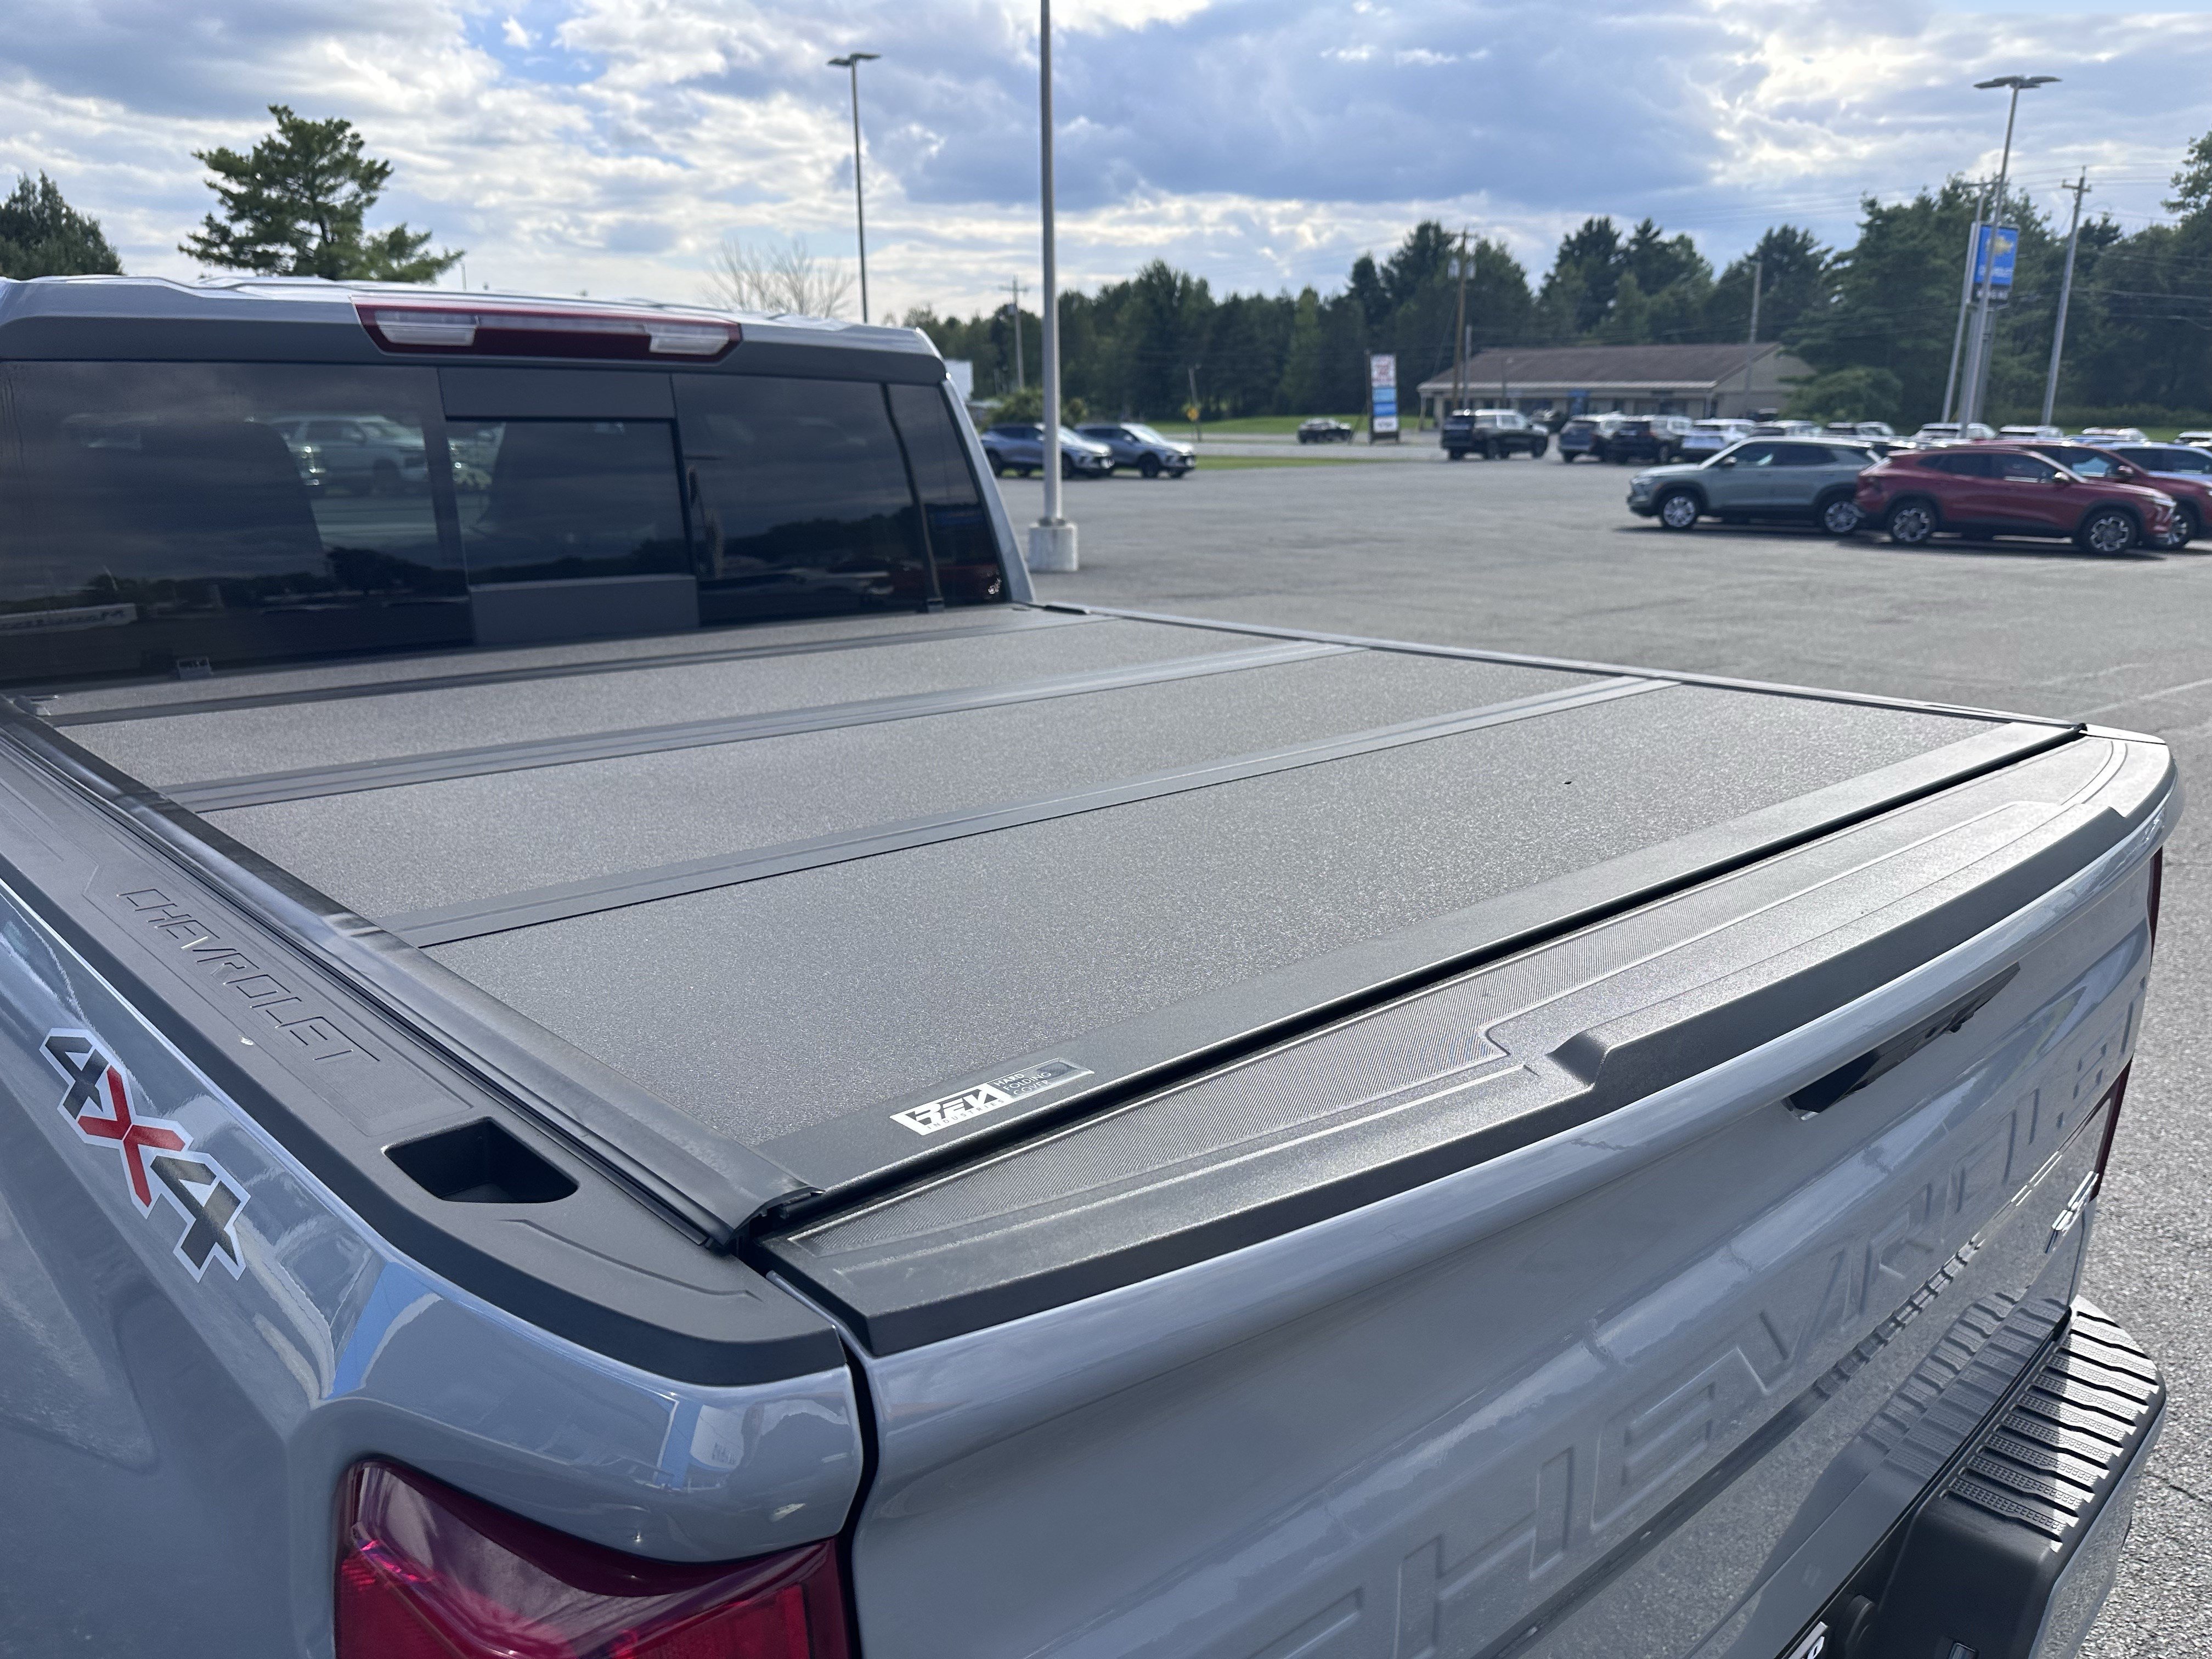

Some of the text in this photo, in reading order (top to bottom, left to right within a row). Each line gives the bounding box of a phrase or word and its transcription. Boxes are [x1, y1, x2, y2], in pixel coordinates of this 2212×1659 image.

[117, 888, 380, 1062] CHEVROLET
[994, 1073, 1025, 1087] HARD
[1003, 1071, 1052, 1091] FOLDING
[905, 1088, 998, 1125] BAK
[927, 1099, 1005, 1130] INDUSTRIES
[1242, 975, 2147, 1658] HEVROLET
